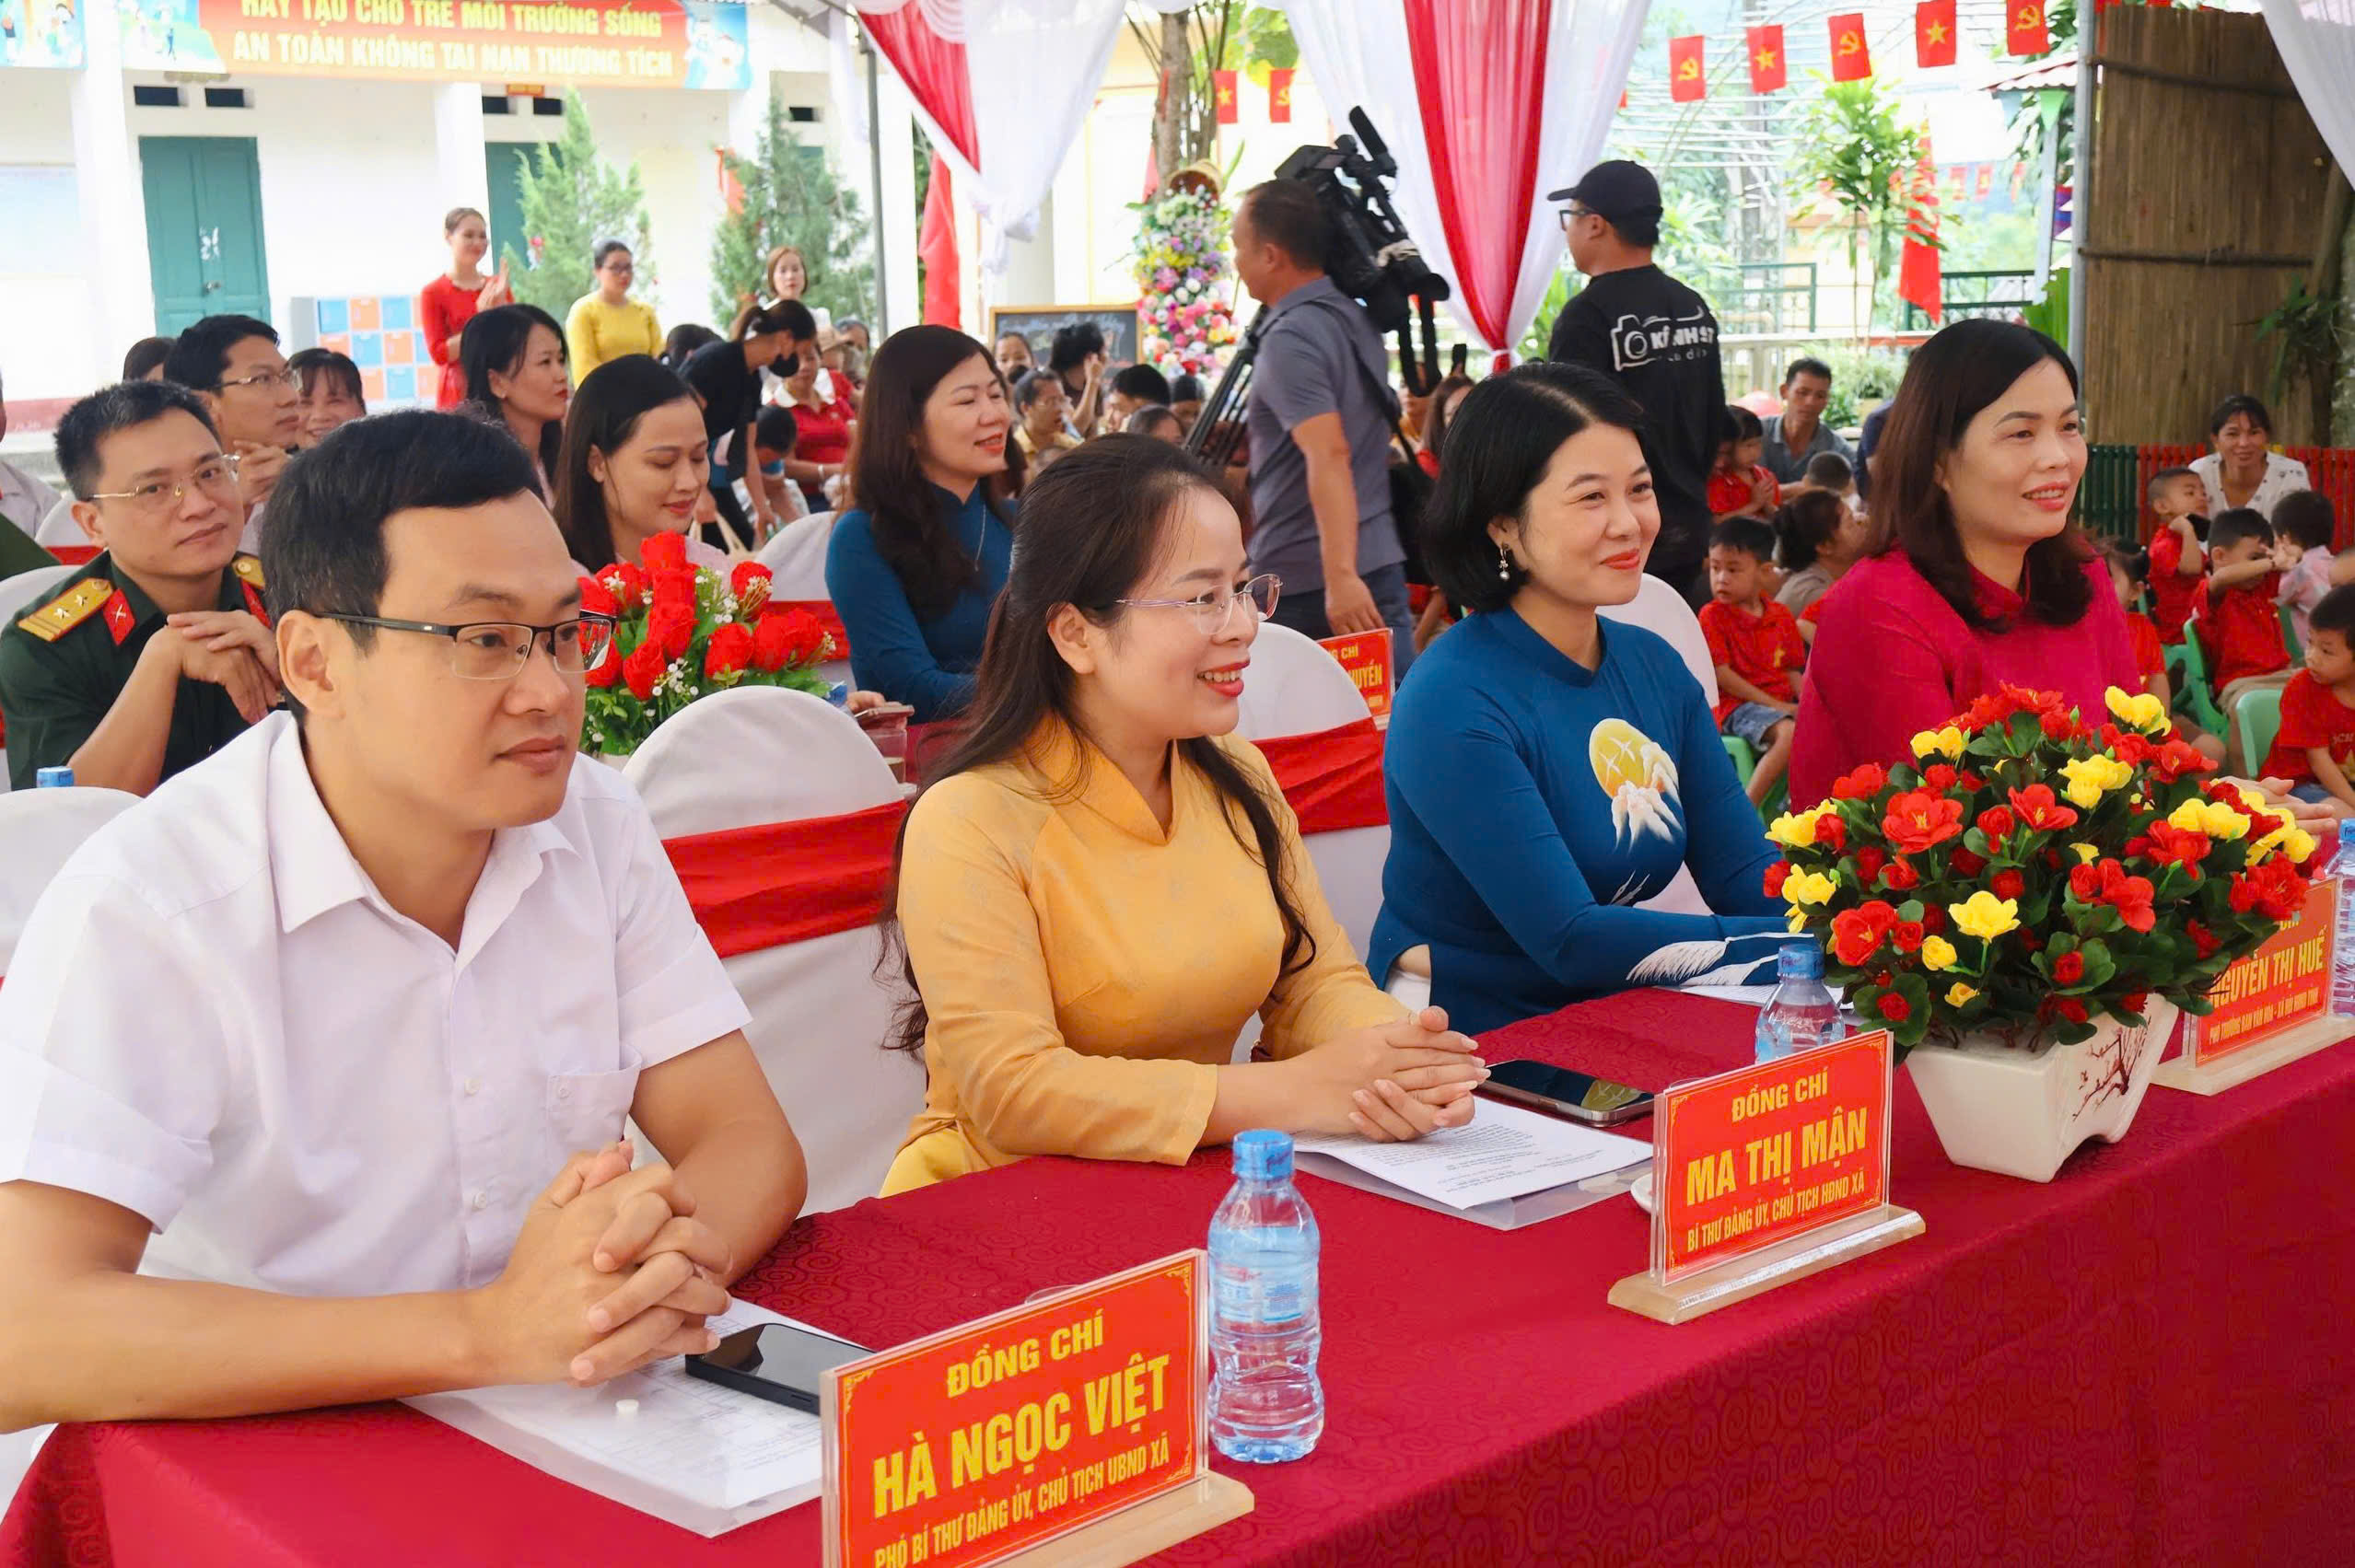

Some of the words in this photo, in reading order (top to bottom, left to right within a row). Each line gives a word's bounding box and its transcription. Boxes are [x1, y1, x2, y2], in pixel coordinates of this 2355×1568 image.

[234, 30, 270, 61] AN
[352, 33, 436, 68] KHÔNG
[2273, 947, 2293, 987] THỊ
[1731, 1085, 1789, 1122] ĐỒNG
[1795, 1067, 1828, 1102] CHÍ
[1686, 1149, 1736, 1206] MA
[1746, 1131, 1792, 1186] THỊ
[1801, 1106, 1868, 1168] MẬN
[1687, 1225, 1699, 1253] BÍ
[1724, 1208, 1753, 1239] ĐẢNG
[1772, 1187, 1793, 1222] CHỦ
[1796, 1185, 1819, 1219] TỊCH
[946, 1337, 1040, 1399] ĐỒNG
[1050, 1307, 1103, 1362] CHÍ
[873, 1428, 938, 1519] HÀ
[950, 1390, 1071, 1490] NGỌC
[1083, 1352, 1170, 1436] VIỆT
[875, 1536, 908, 1568] PHÓ
[913, 1523, 929, 1564] BÍ
[932, 1518, 966, 1559] THƯ
[966, 1499, 1008, 1543] ĐẢNG
[1012, 1482, 1034, 1526] ỦY,
[1038, 1469, 1068, 1515] CHỦ
[1073, 1463, 1105, 1507] TỊCH
[1108, 1450, 1148, 1487] UBND
[1149, 1431, 1170, 1467] XÃ
